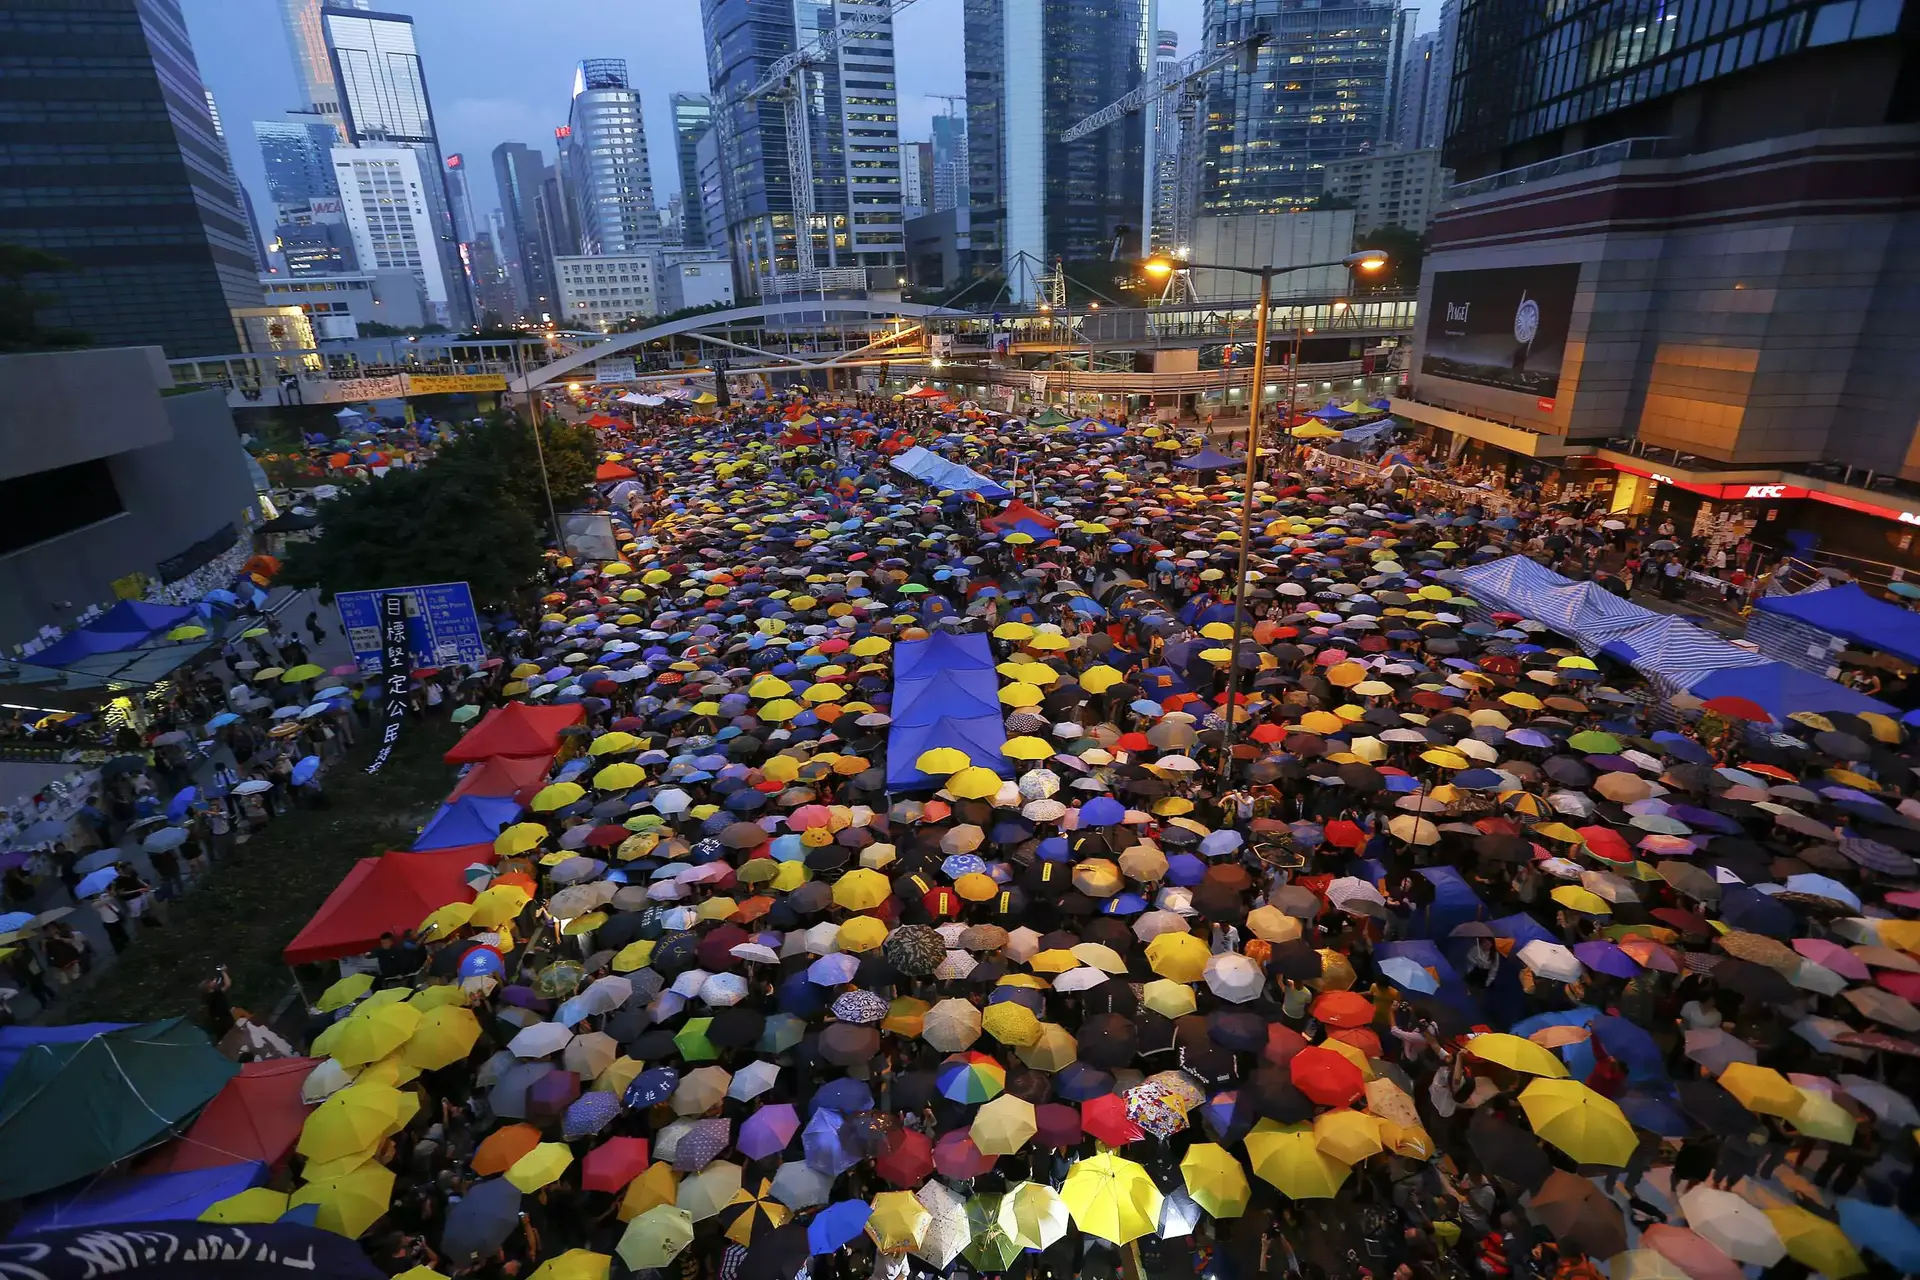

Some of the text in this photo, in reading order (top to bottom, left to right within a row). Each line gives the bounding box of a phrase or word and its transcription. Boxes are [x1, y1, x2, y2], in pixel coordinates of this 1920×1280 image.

[312, 202, 341, 214] YMCA
[1446, 301, 1471, 323] PIAGET
[1744, 485, 1786, 498] KFC
